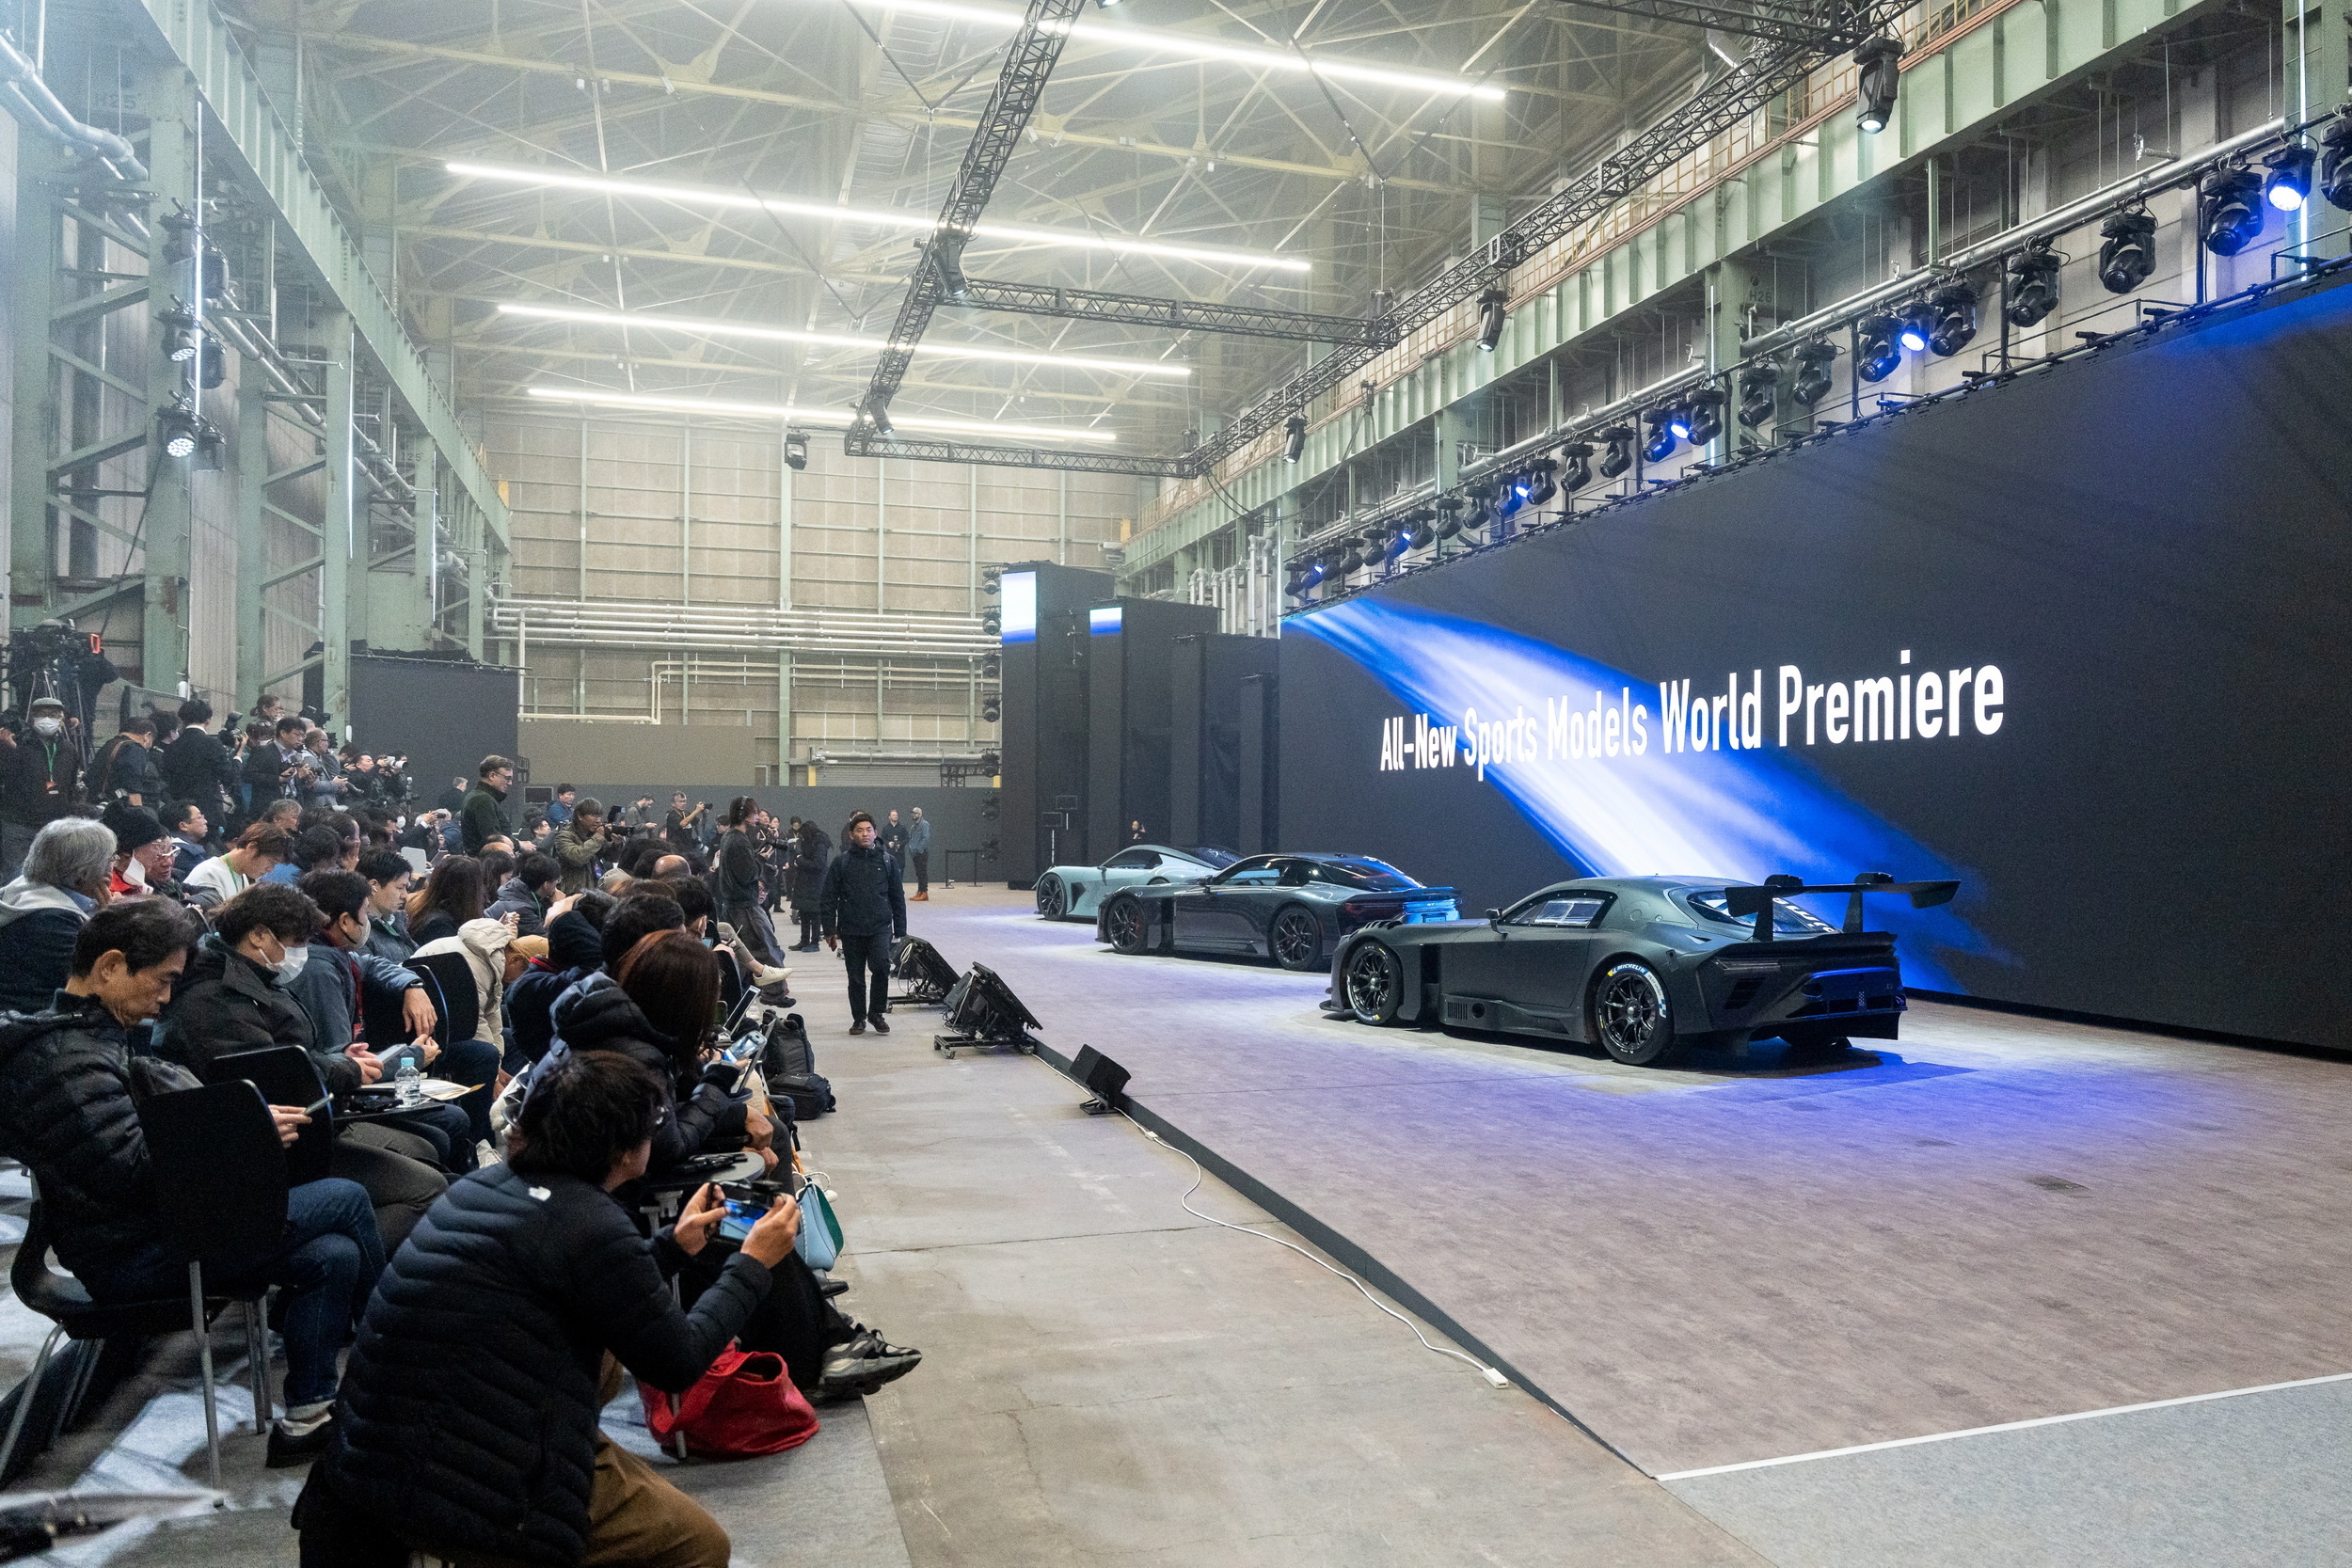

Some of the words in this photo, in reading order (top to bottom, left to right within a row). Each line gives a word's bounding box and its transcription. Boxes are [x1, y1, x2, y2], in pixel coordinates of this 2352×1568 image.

[1750, 290, 1772, 303] H26
[1380, 713, 1457, 771] All-New
[1464, 705, 1537, 782] Sports
[1548, 687, 1648, 761] Models
[1660, 669, 1762, 753] World
[1779, 649, 2004, 748] Premiere
[1617, 963, 1645, 973] MICHELIN
